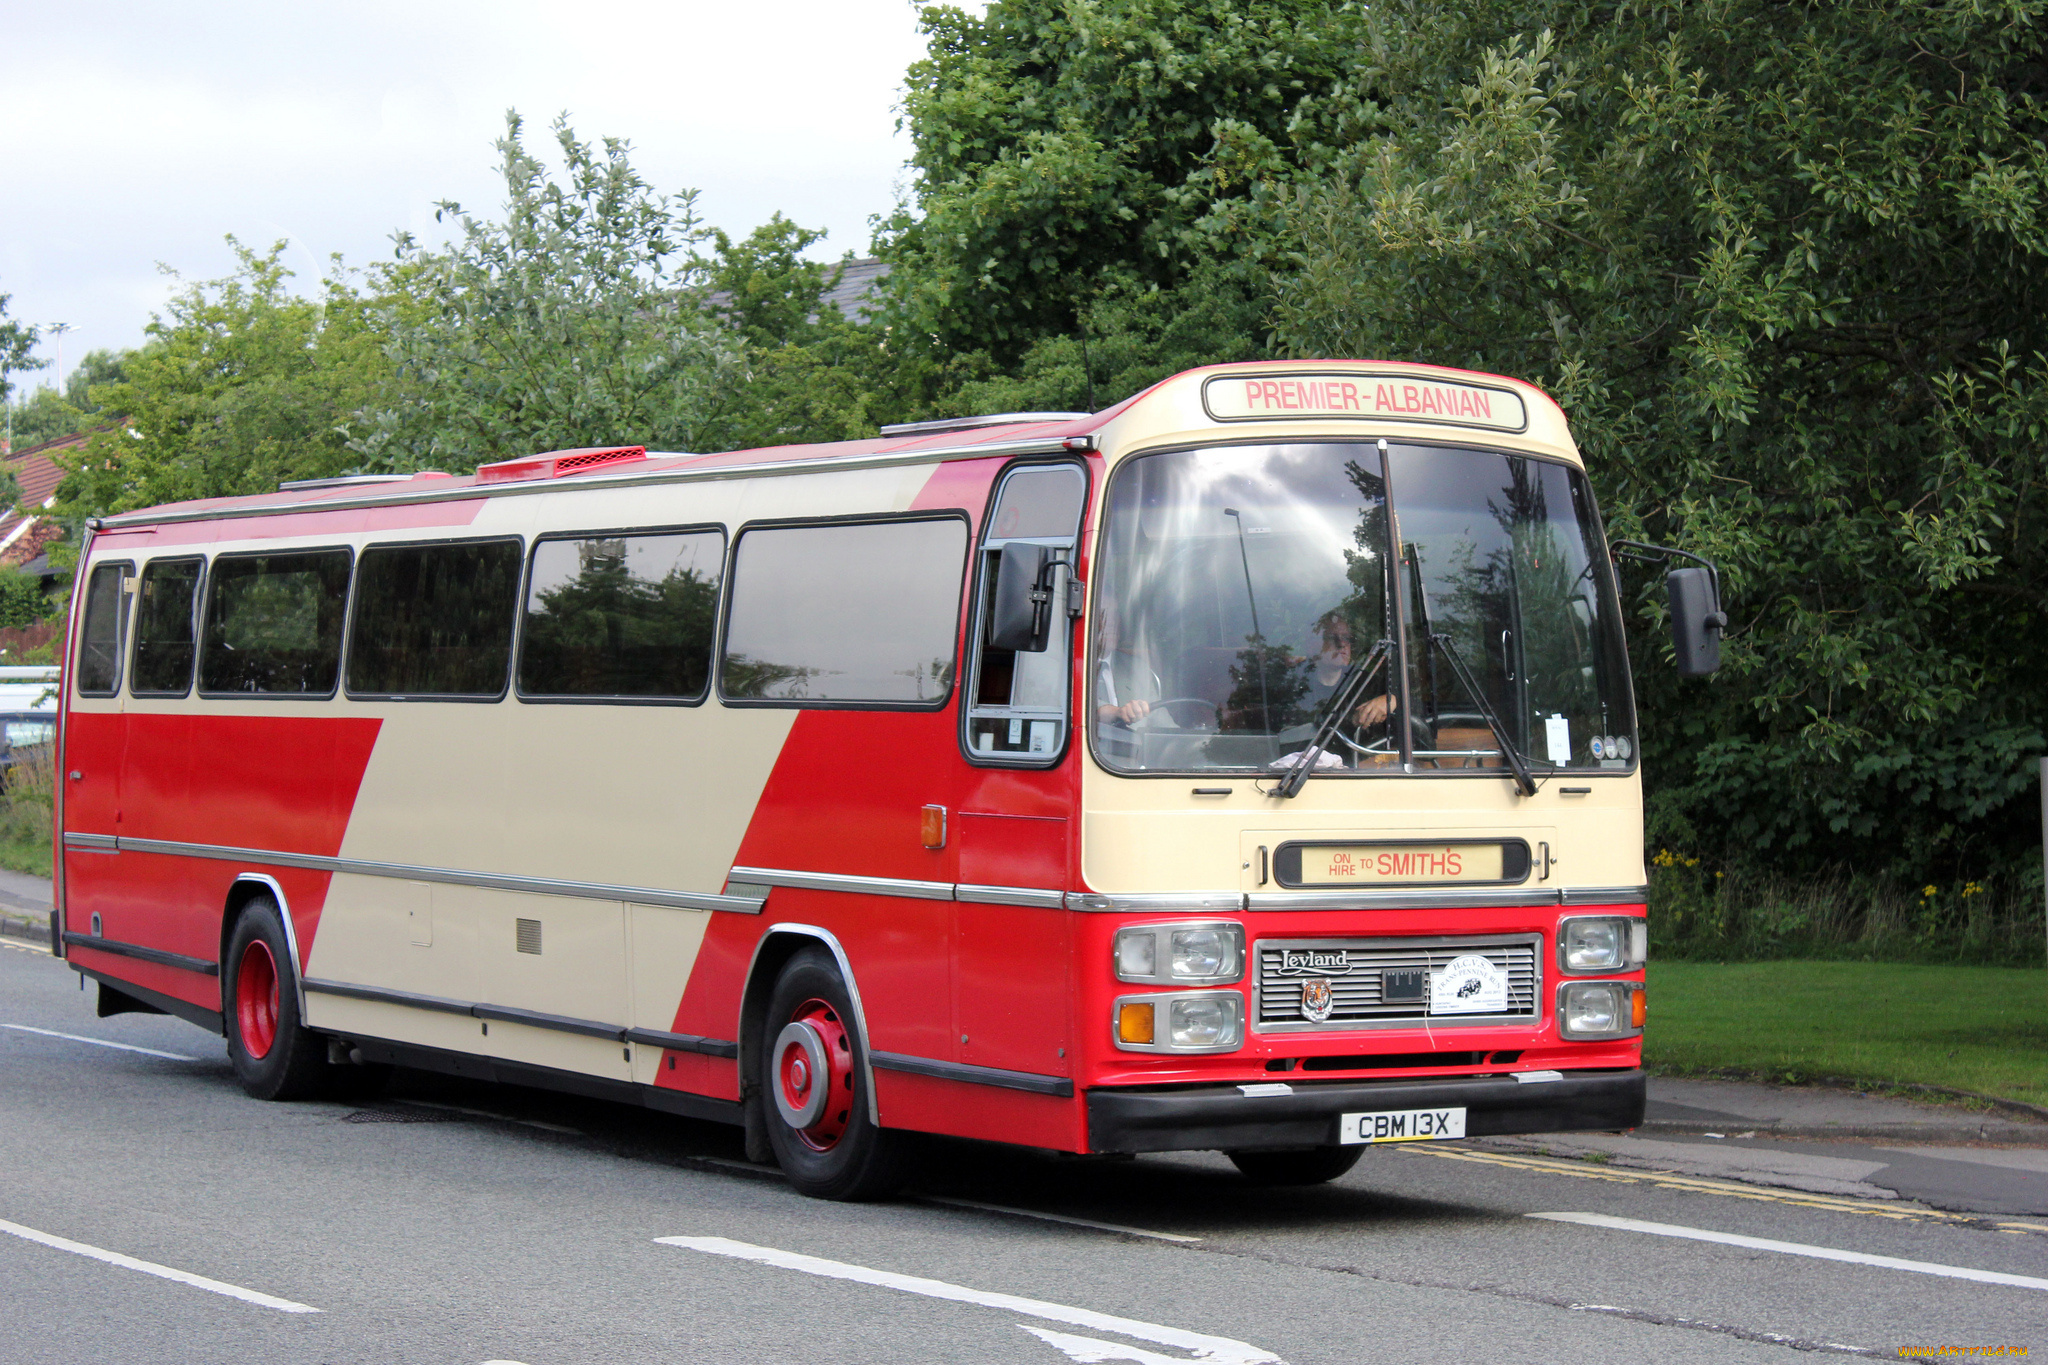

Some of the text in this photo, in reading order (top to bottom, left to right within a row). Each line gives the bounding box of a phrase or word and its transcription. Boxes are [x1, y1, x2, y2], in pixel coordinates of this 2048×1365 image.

[1245, 381, 1492, 419] PREMIER-ALBANIAN
[1329, 865, 1356, 876] HIRE
[1333, 853, 1351, 864] ON
[1360, 848, 1462, 876] TO SMITH'S
[1278, 950, 1352, 975] Leyland
[1489, 975, 1501, 989] RUN
[1359, 1112, 1449, 1138] CBM 13X
